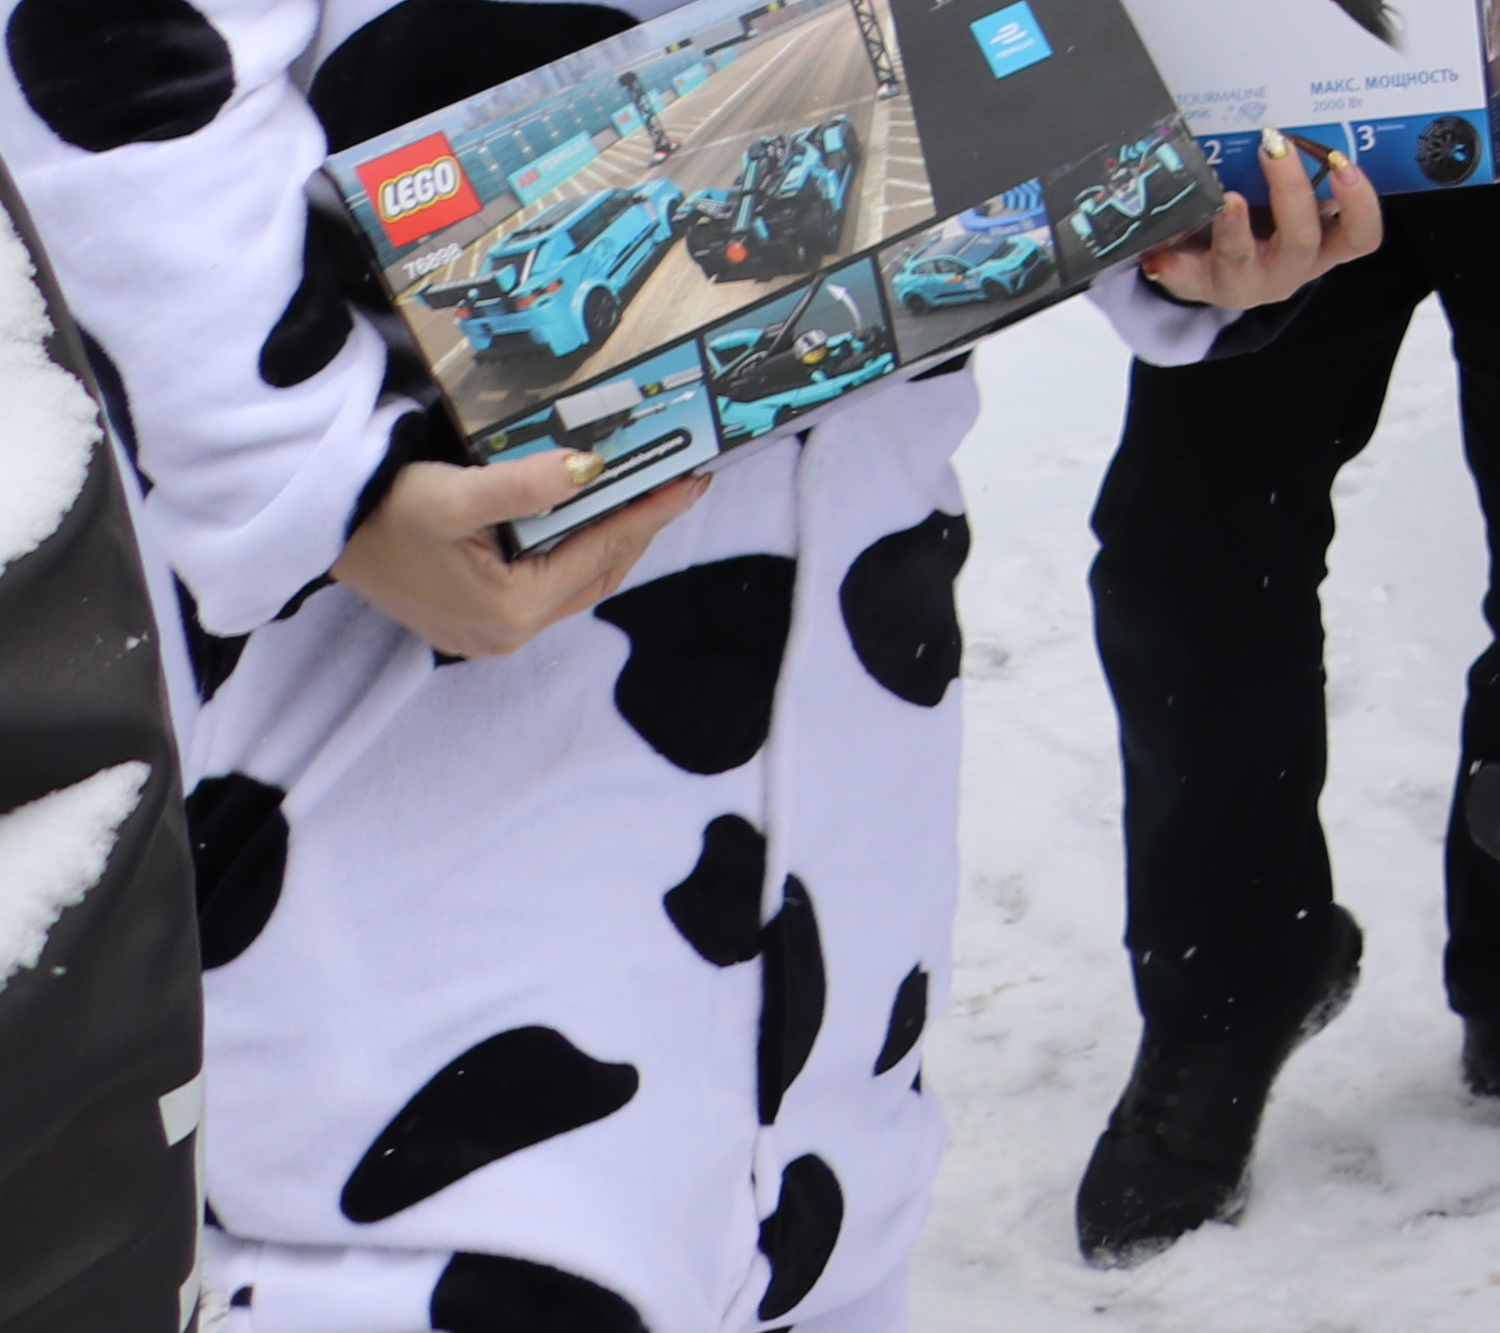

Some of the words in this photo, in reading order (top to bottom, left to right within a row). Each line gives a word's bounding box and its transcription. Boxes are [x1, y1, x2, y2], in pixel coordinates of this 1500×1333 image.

[1310, 73, 1361, 96] МАКС.
[1365, 68, 1459, 90] МОЩНОСТЬ
[1356, 124, 1376, 151] 3
[1204, 139, 1223, 166] 2
[383, 161, 456, 218] LEGO
